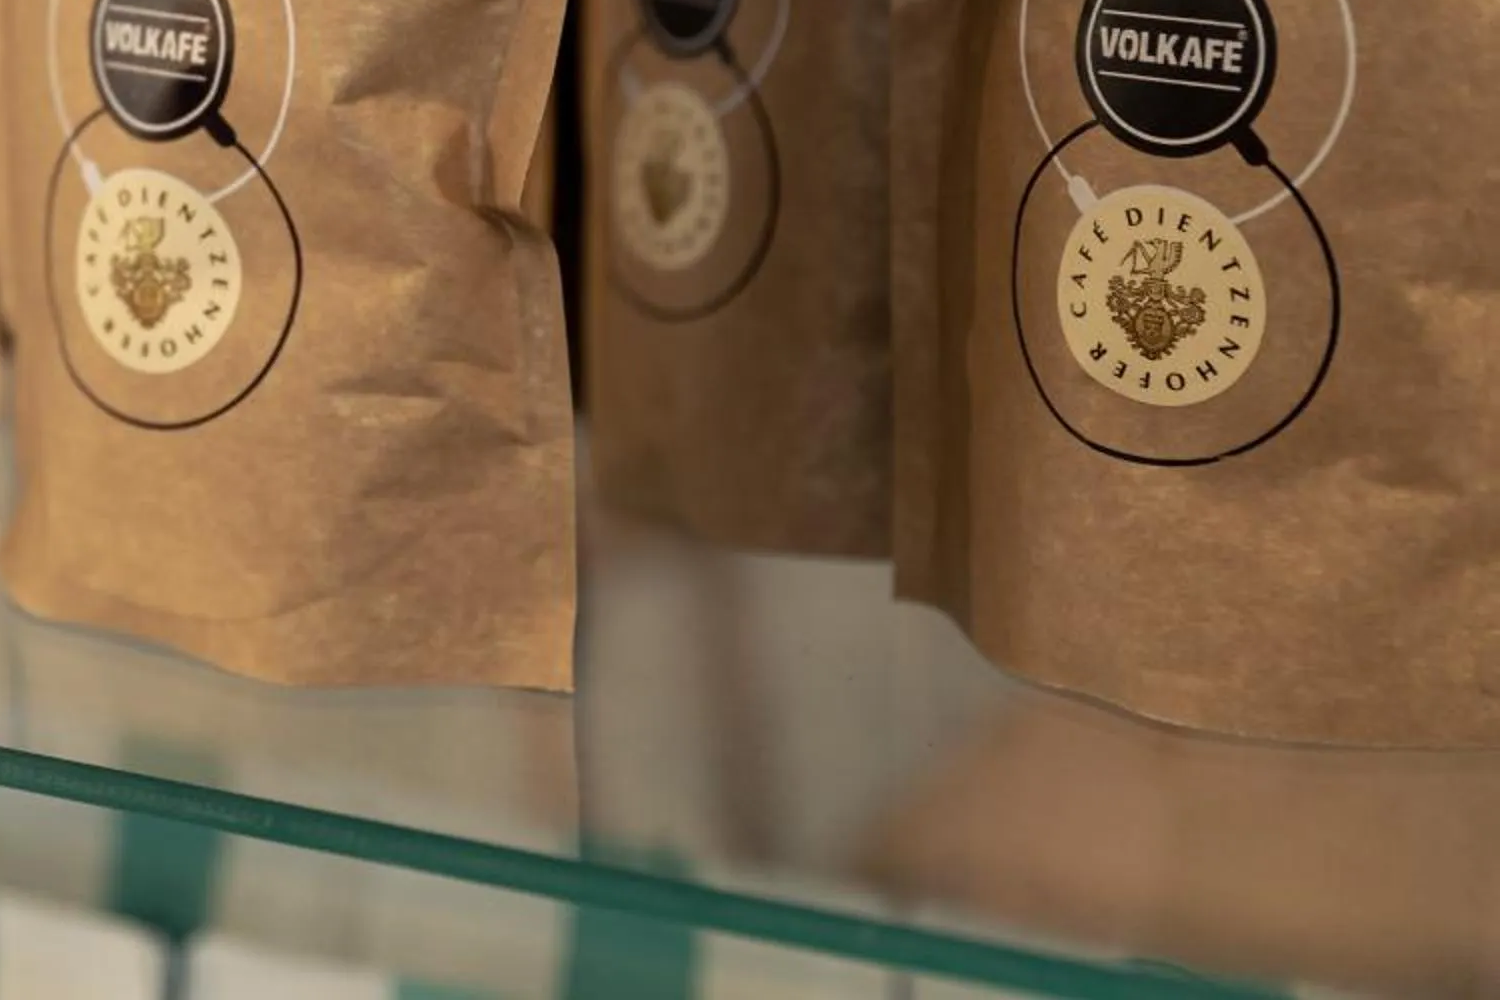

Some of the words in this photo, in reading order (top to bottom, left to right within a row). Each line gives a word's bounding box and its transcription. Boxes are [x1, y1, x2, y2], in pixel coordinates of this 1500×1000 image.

[105, 20, 209, 66] VOLKAFE
[1100, 25, 1244, 74] VOLKAFE
[1069, 219, 1110, 319] CAFÉ
[1088, 206, 1251, 392] DIENTZENHOFER
